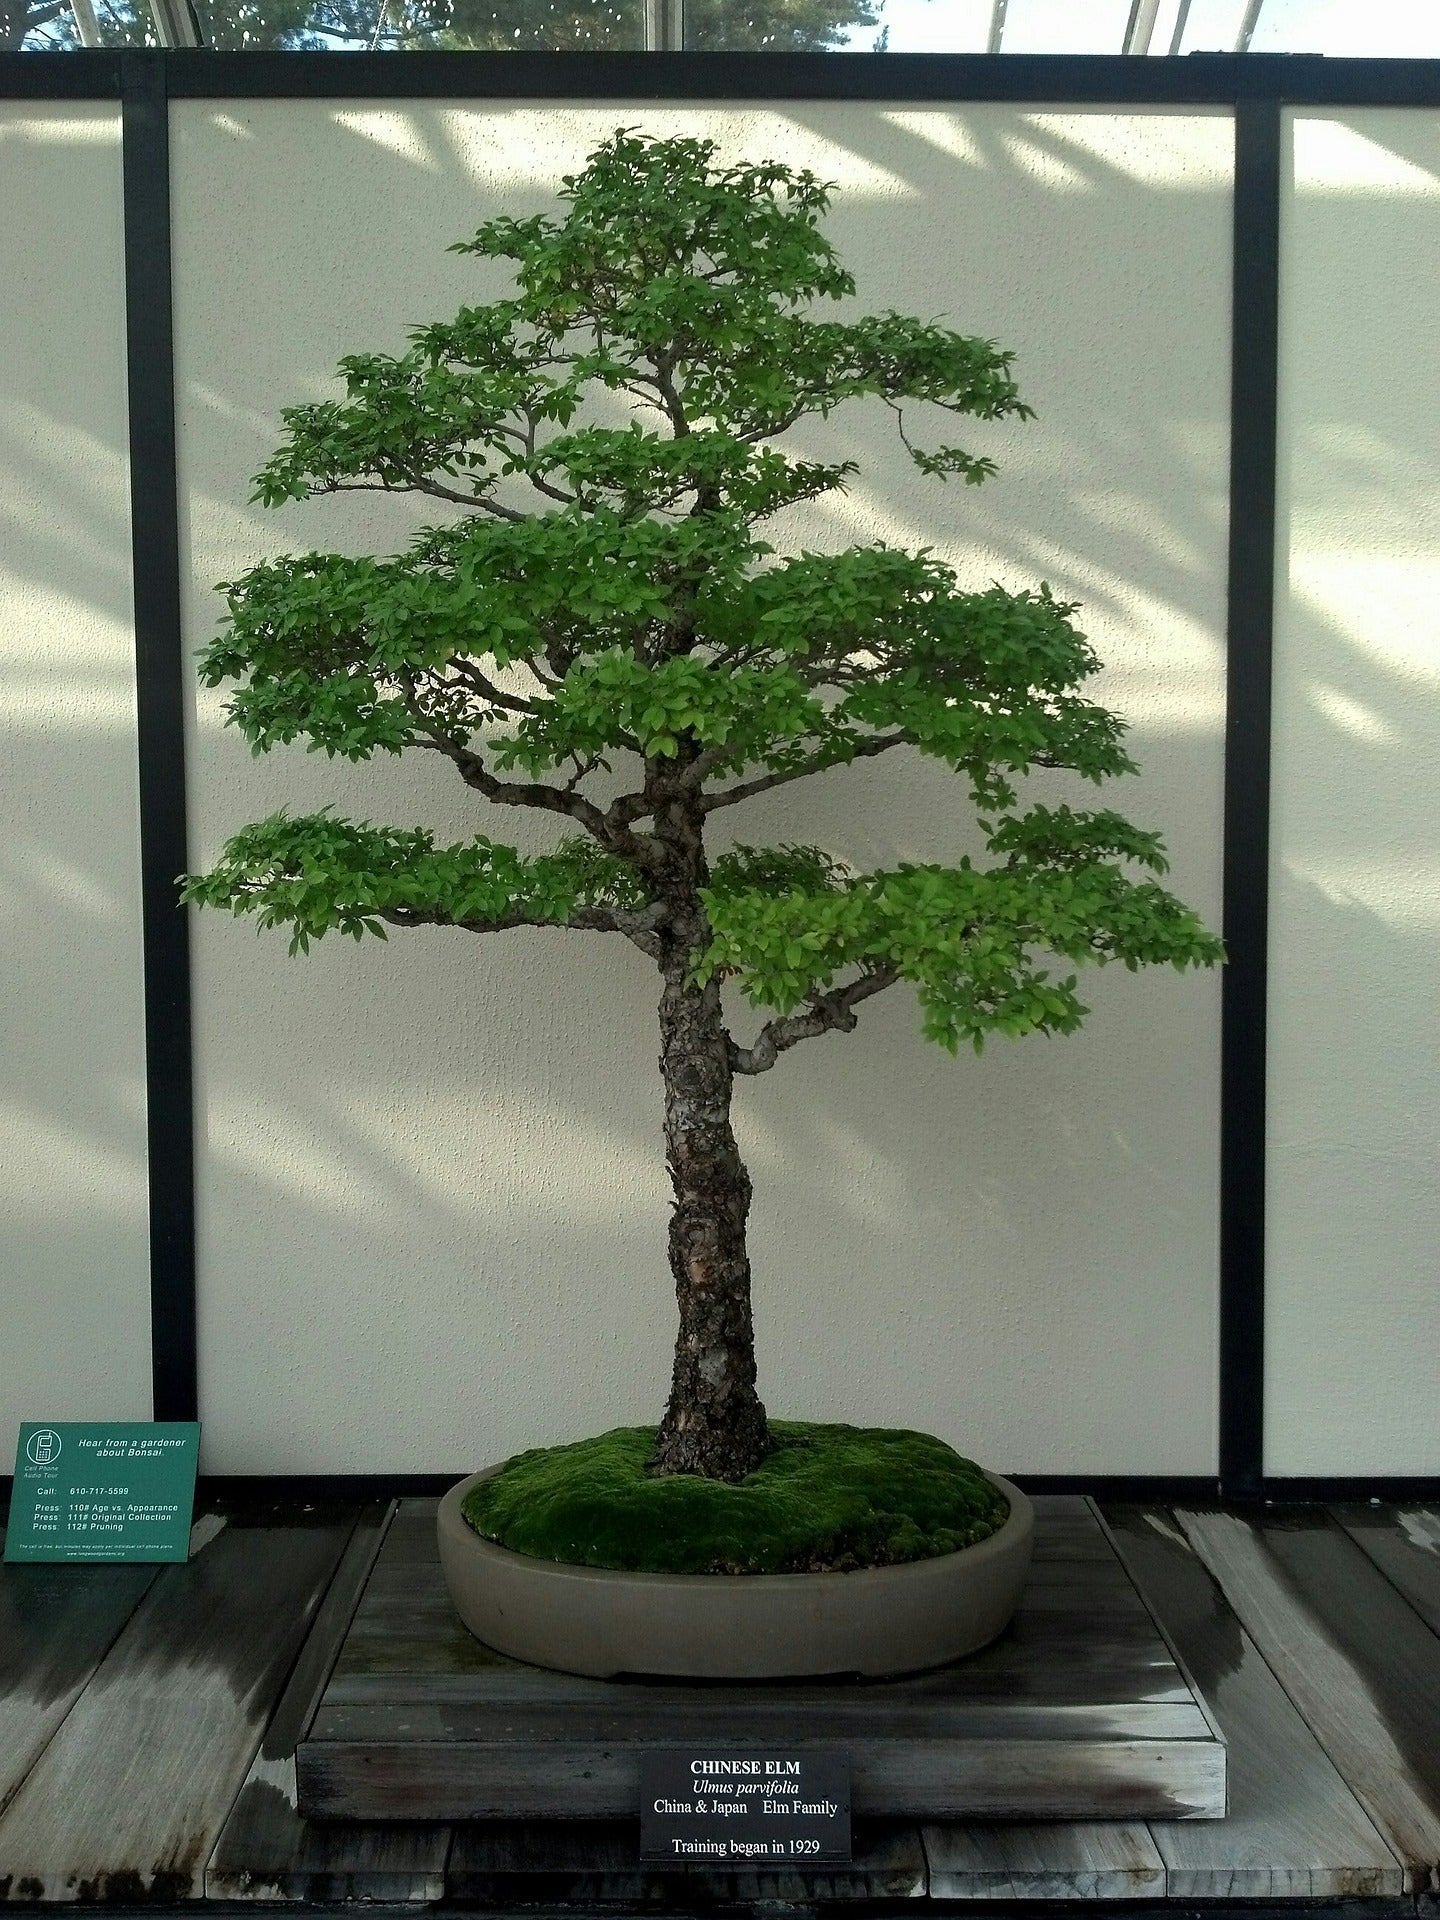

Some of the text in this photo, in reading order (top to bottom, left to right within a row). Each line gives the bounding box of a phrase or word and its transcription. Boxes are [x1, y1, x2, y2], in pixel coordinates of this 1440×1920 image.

[78, 1439, 101, 1447] Hear
[141, 1439, 186, 1448] gardener
[92, 1504, 109, 1512] Age
[127, 1504, 178, 1512] Appearance
[91, 1513, 125, 1522] Original
[90, 1523, 123, 1532] Pruning
[691, 1761, 800, 1774] CHINESE ELM
[693, 1780, 799, 1797] Ulmus parvifolia
[654, 1800, 837, 1817] China & Japan Elm Family
[672, 1839, 820, 1856] Training began in 1929
